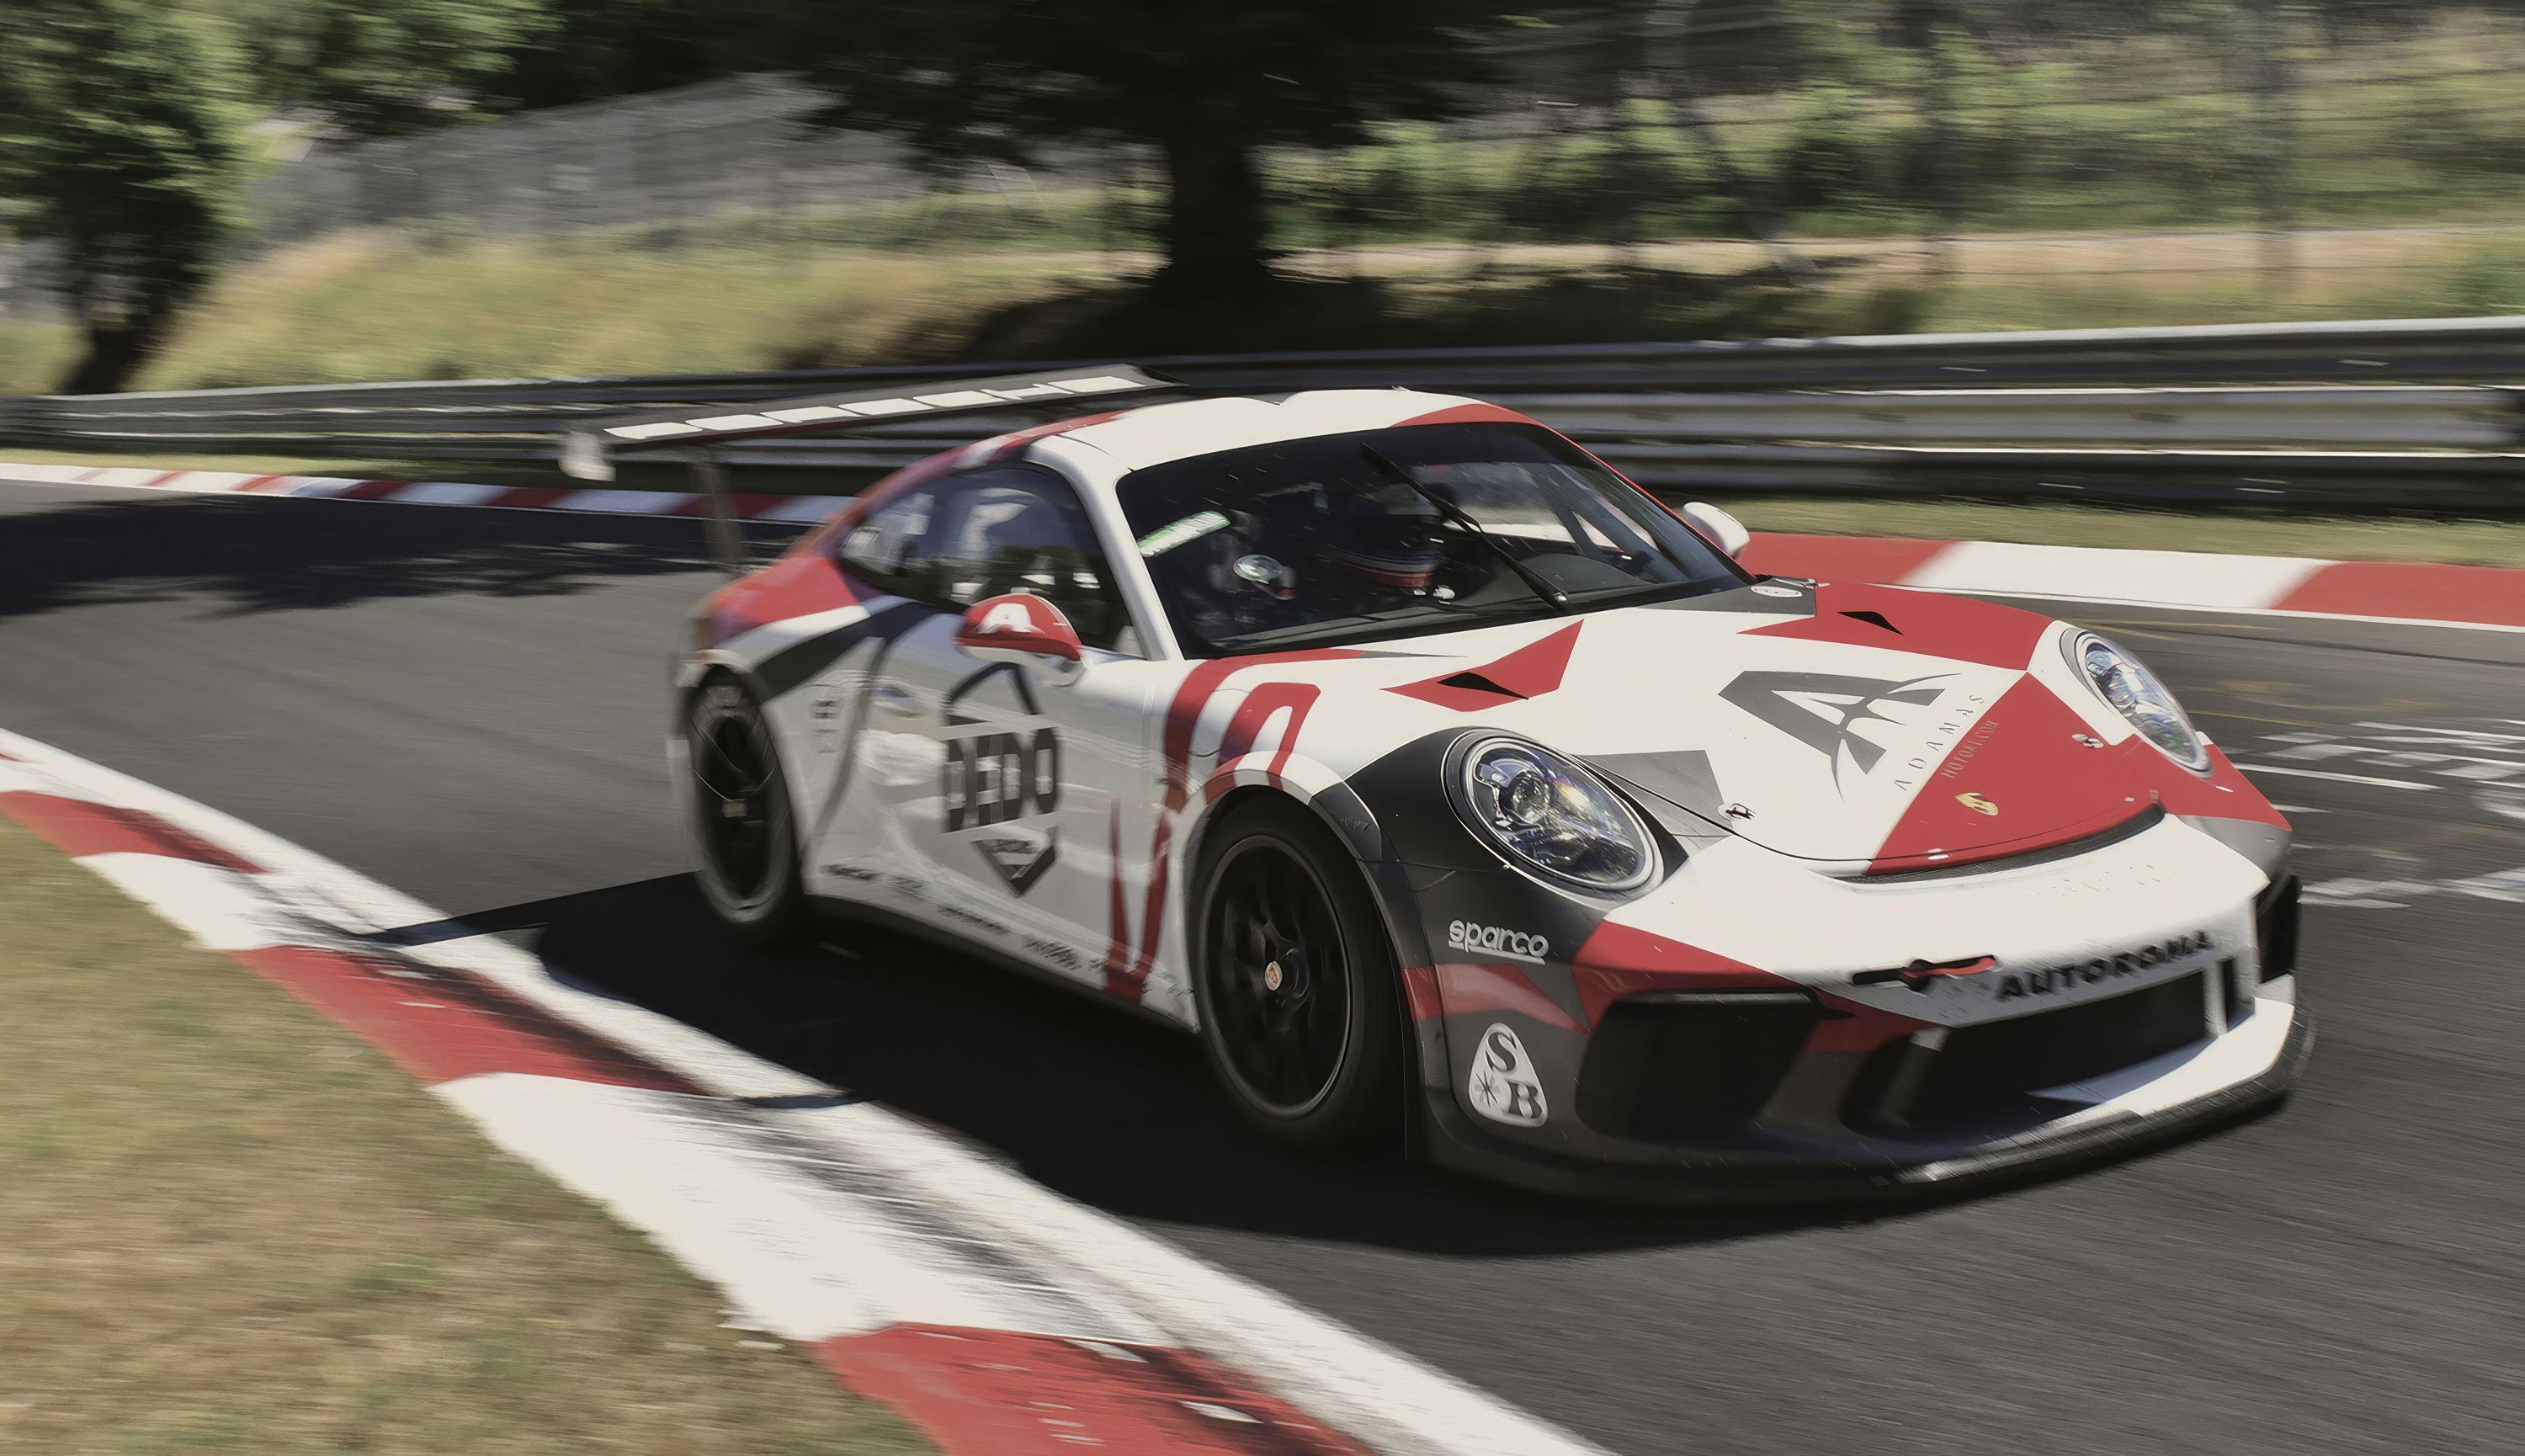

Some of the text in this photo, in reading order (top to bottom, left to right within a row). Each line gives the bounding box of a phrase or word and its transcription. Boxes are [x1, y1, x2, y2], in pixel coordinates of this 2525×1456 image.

[1893, 694, 1985, 792] ADAMAS
[944, 729, 1058, 833] DEDO
[1449, 919, 1550, 959] sparco
[1994, 930, 2214, 1003] AUTOROMA
[1485, 1031, 1518, 1073] S
[1501, 1080, 1544, 1119] B
